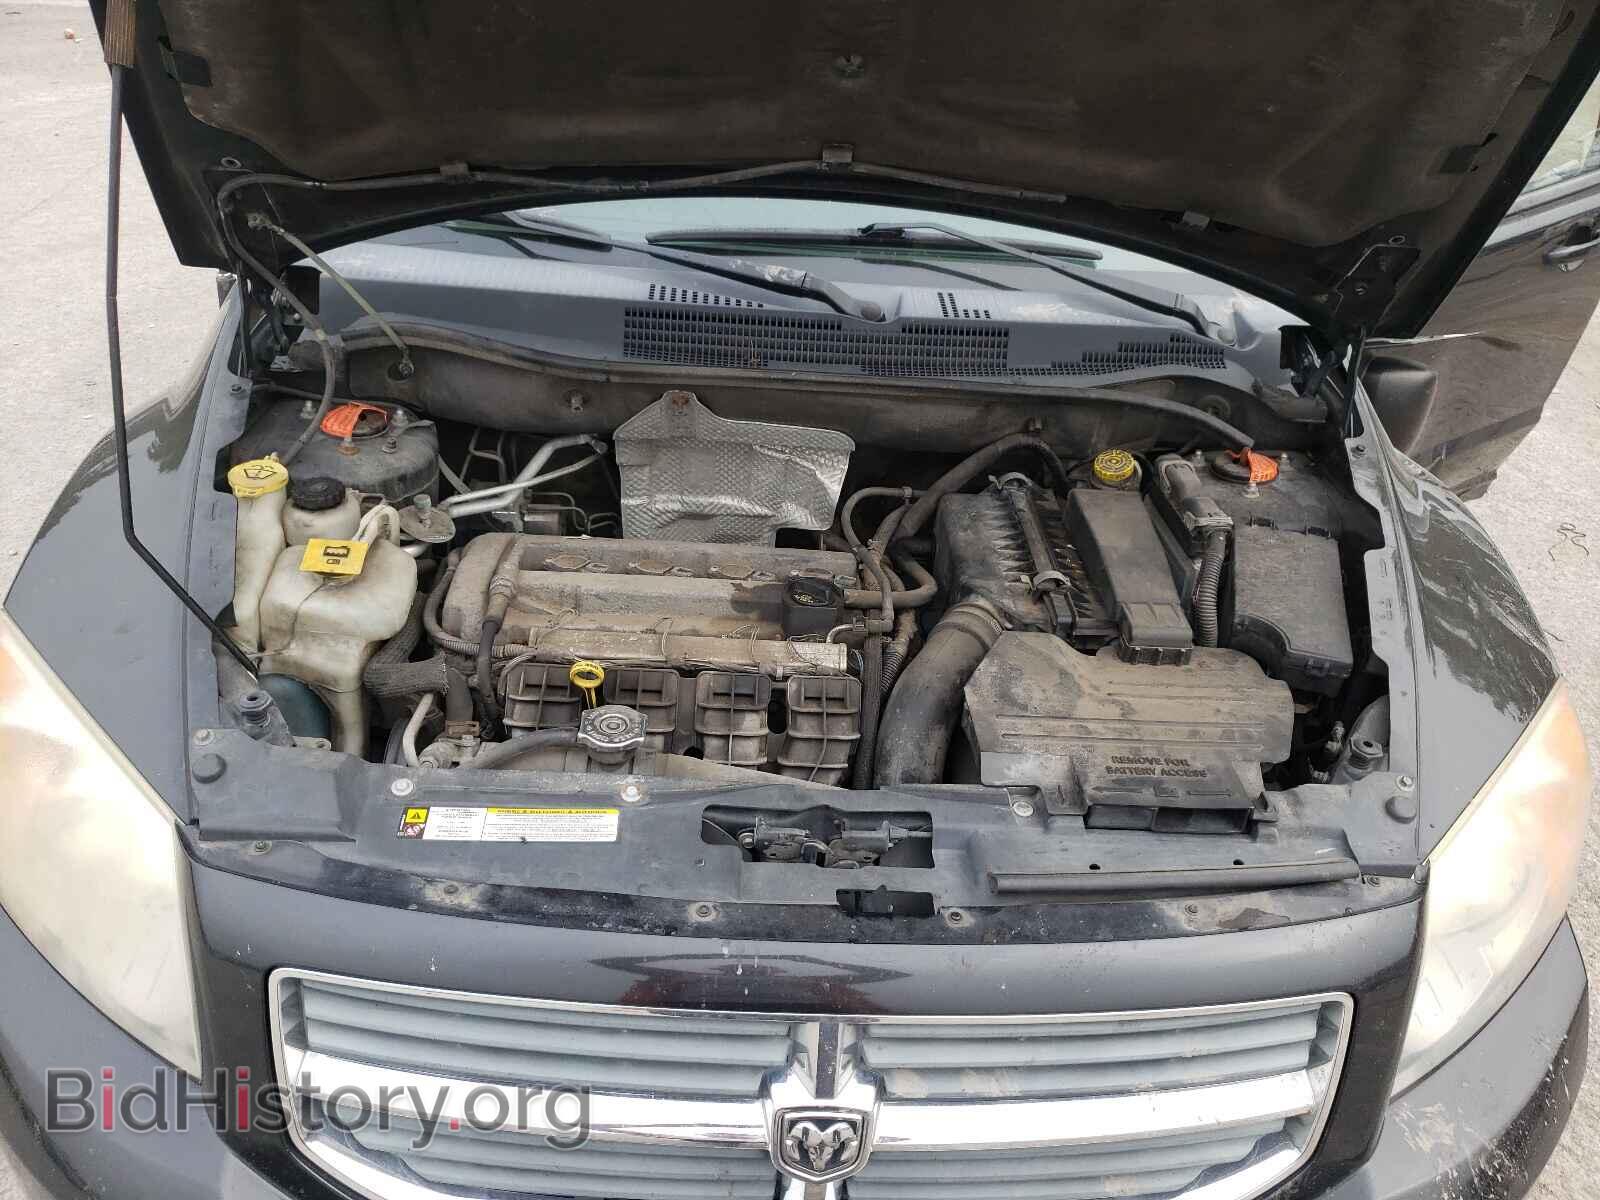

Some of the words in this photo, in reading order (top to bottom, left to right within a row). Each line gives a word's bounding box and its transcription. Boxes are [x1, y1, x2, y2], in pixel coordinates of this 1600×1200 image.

[1111, 755, 1162, 766] REMOVE
[1164, 757, 1191, 767] FOR
[1105, 765, 1156, 776] BATTERY
[1160, 767, 1208, 778] ACCESS
